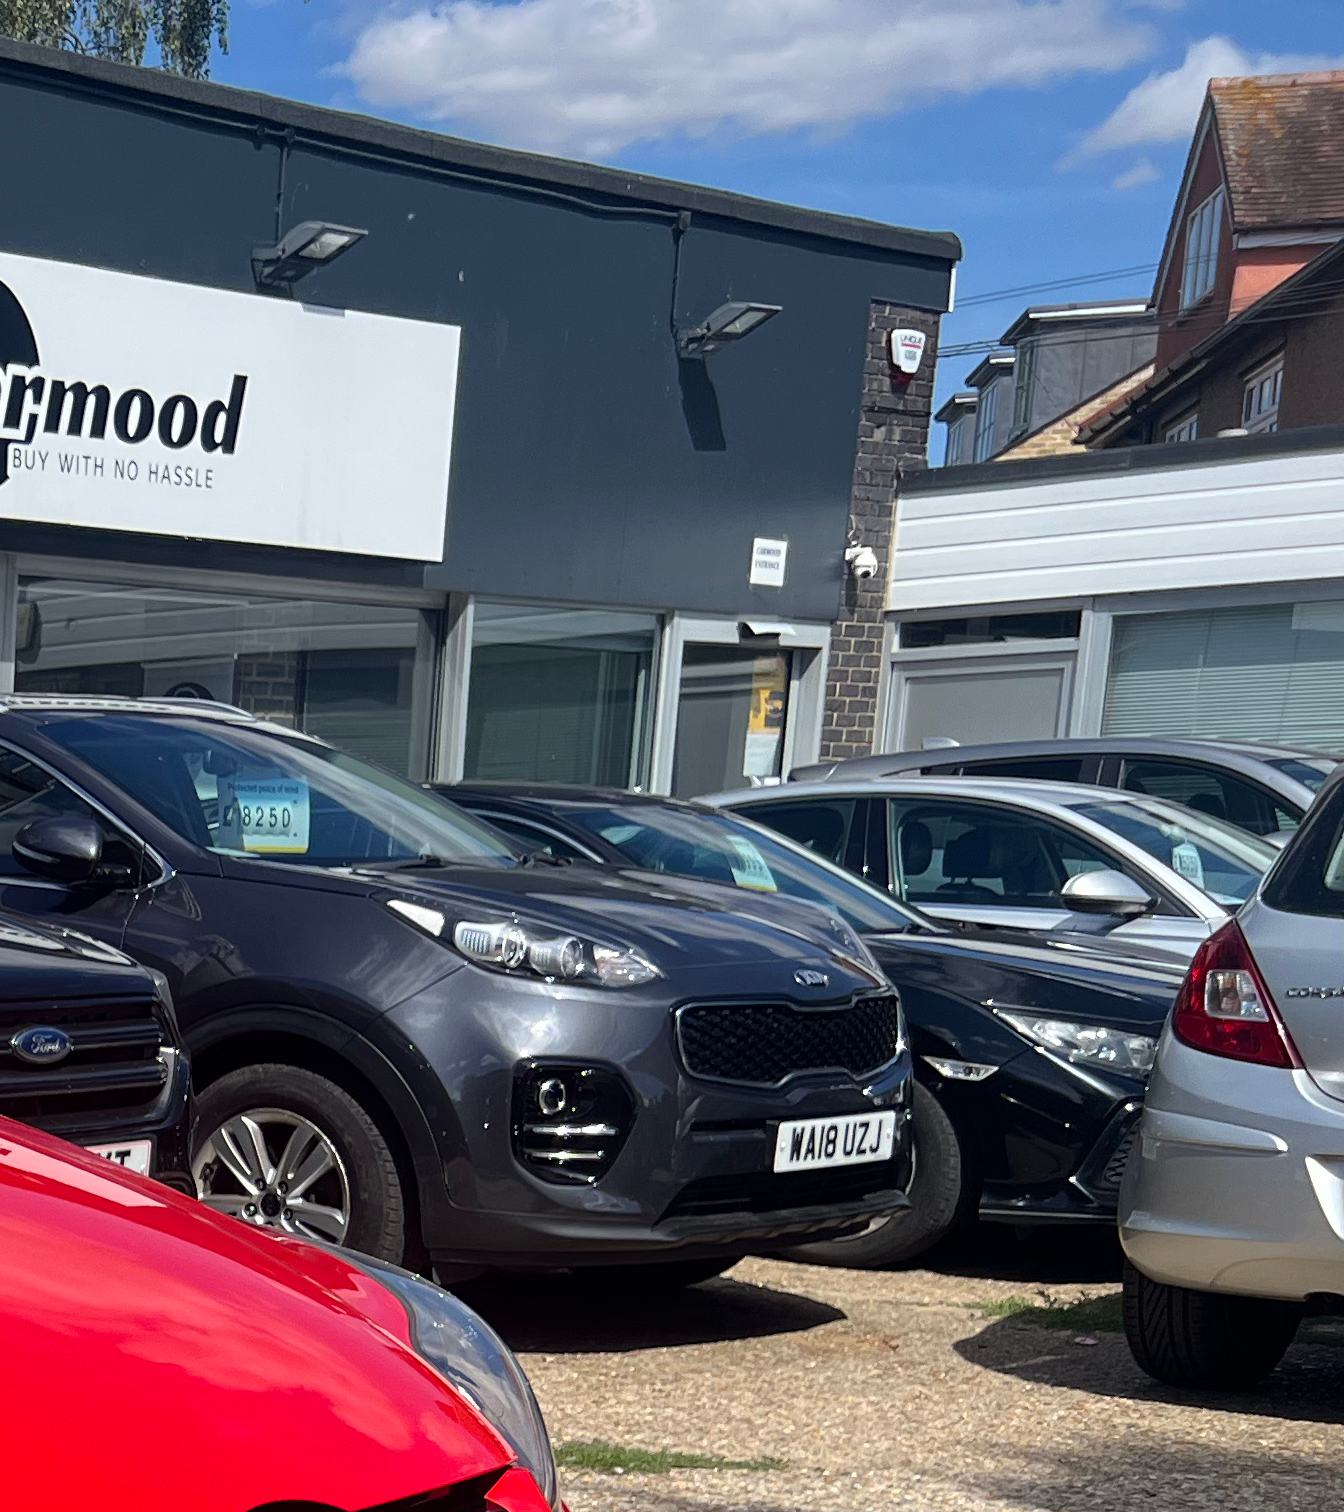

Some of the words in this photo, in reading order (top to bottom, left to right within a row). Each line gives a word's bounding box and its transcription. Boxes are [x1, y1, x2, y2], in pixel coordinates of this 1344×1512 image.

[12, 447, 50, 471] BUY
[58, 453, 105, 477] WITH
[114, 458, 140, 482] NO
[148, 462, 215, 490] HASSLE
[242, 805, 291, 829] 8250
[789, 1124, 839, 1162] WA18
[842, 1119, 883, 1156] UZJ
